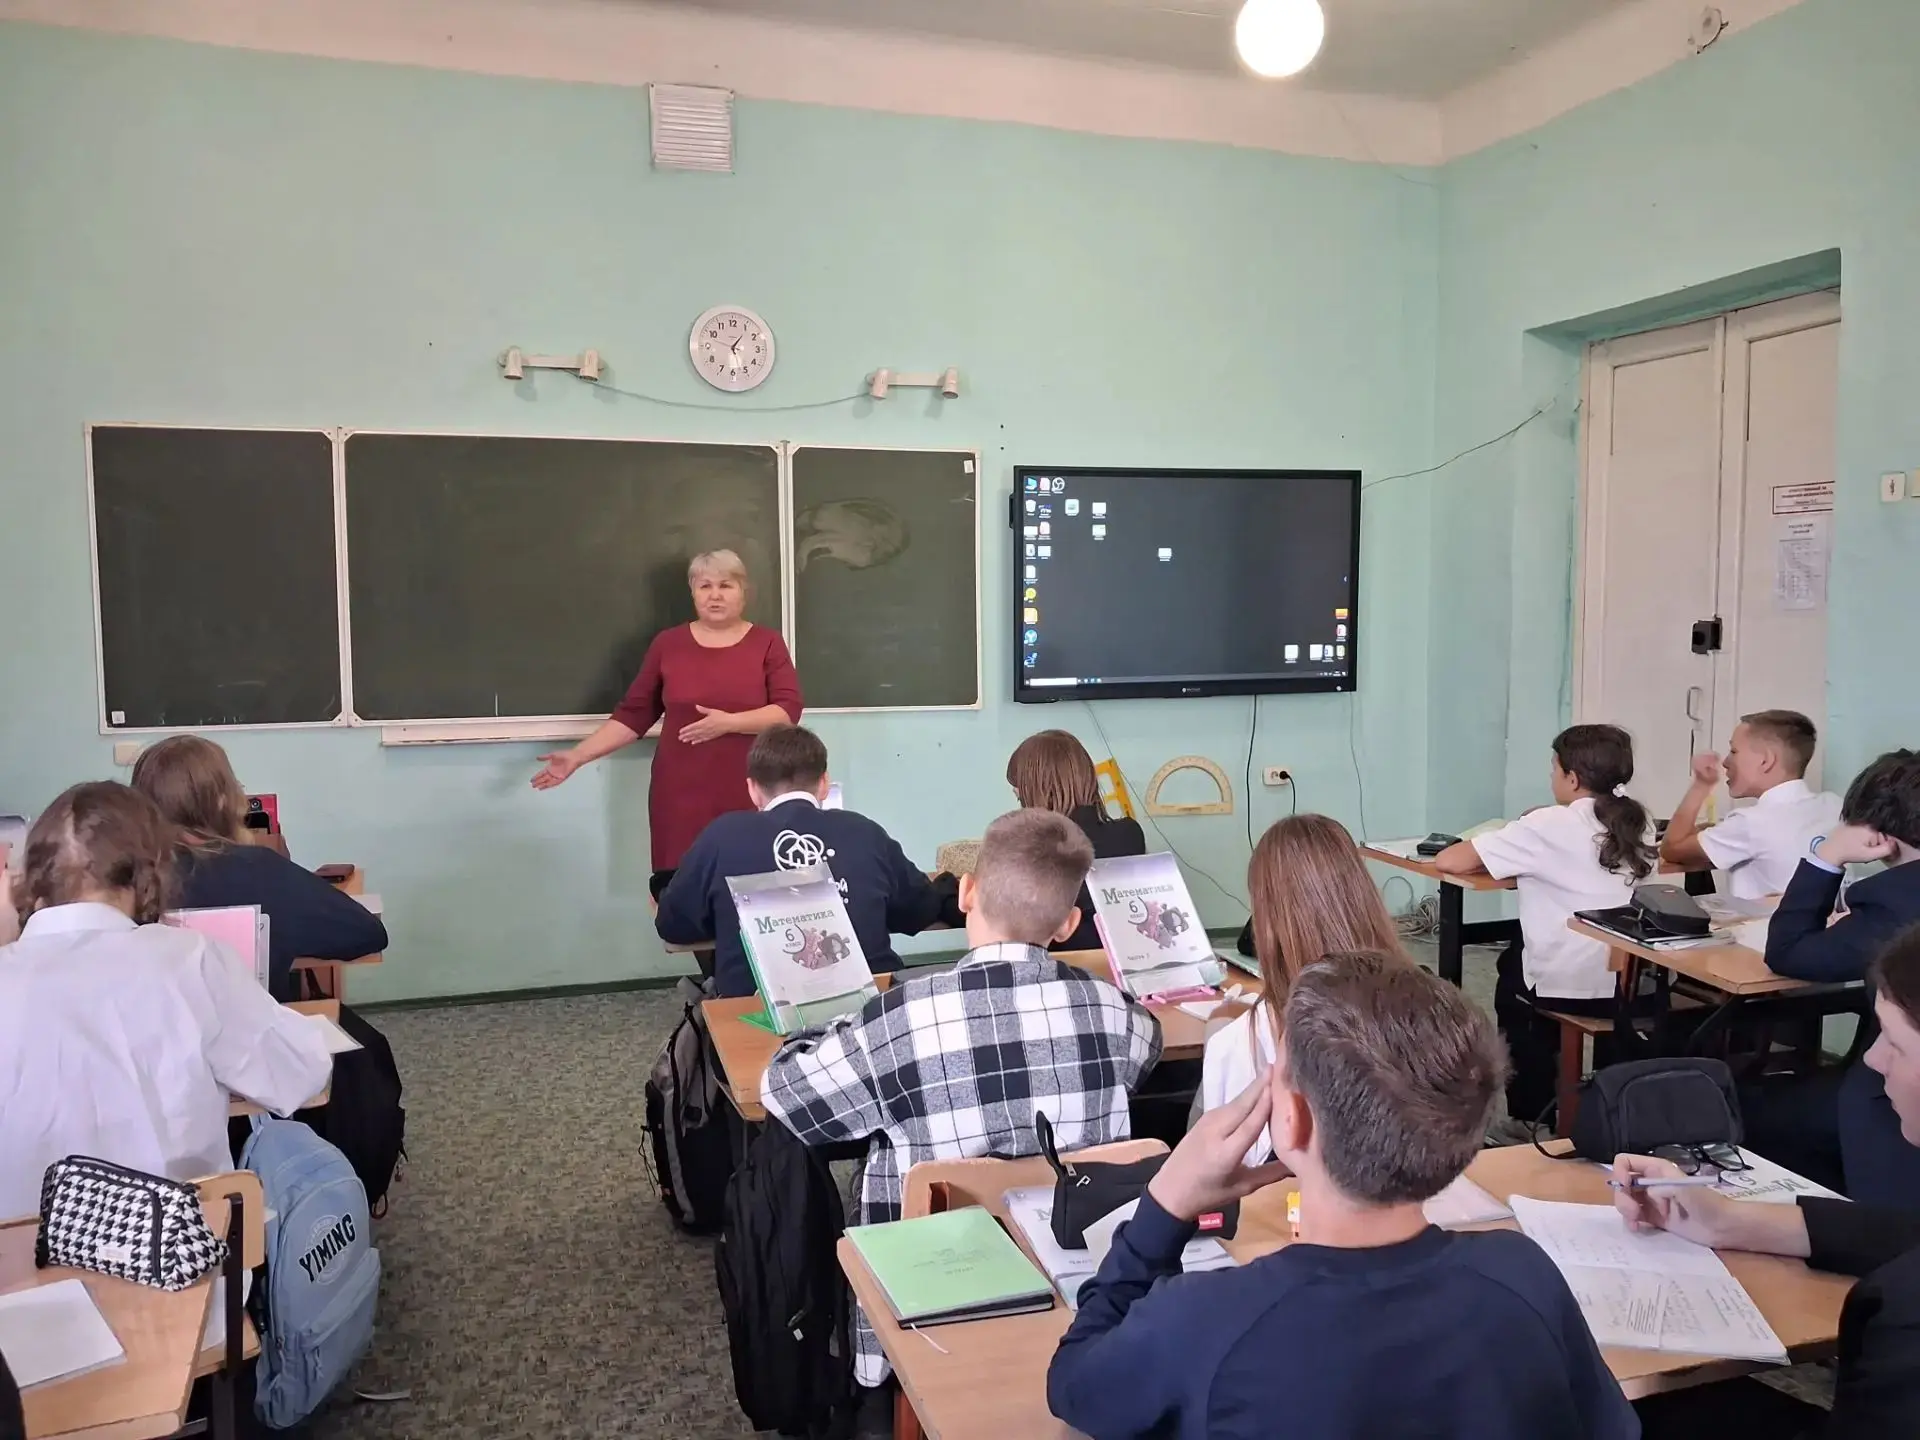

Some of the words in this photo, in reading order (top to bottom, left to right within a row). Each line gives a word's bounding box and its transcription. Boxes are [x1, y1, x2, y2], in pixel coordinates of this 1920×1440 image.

[718, 322, 725, 330] 11
[729, 319, 737, 328] 12
[709, 330, 718, 338] 10
[751, 333, 757, 341] 2
[709, 355, 715, 363] 8
[743, 366, 748, 374] 5
[1101, 884, 1174, 905] Математика
[1128, 900, 1138, 913] 6
[754, 909, 835, 934] Математика
[785, 928, 795, 942] 6
[298, 1213, 356, 1284] YIMING
